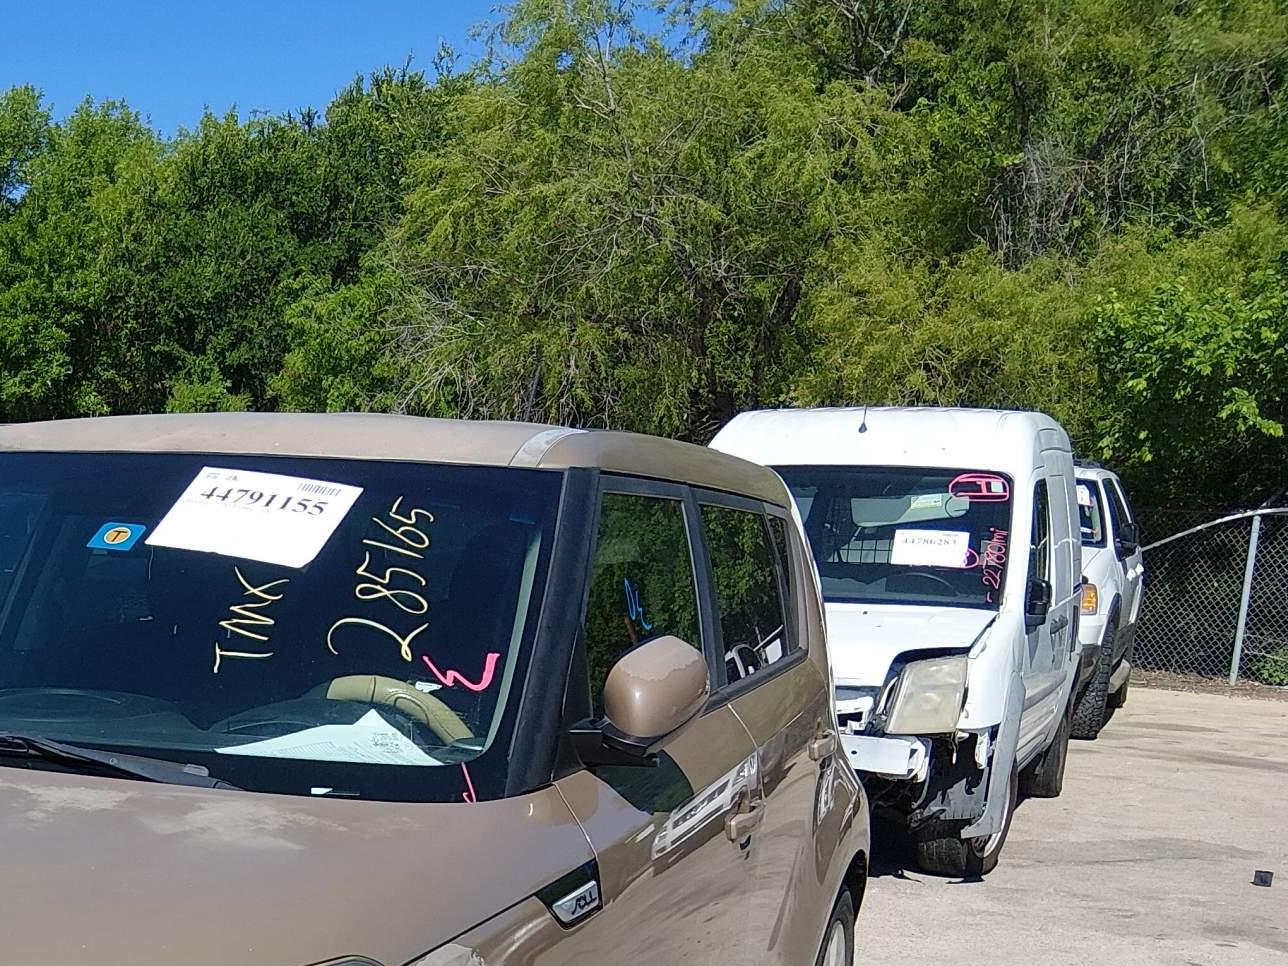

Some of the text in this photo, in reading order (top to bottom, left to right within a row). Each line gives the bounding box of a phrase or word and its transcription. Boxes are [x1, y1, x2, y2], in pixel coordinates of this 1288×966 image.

[199, 485, 329, 517] 44791155
[112, 530, 128, 543] T
[325, 495, 435, 663] 285165
